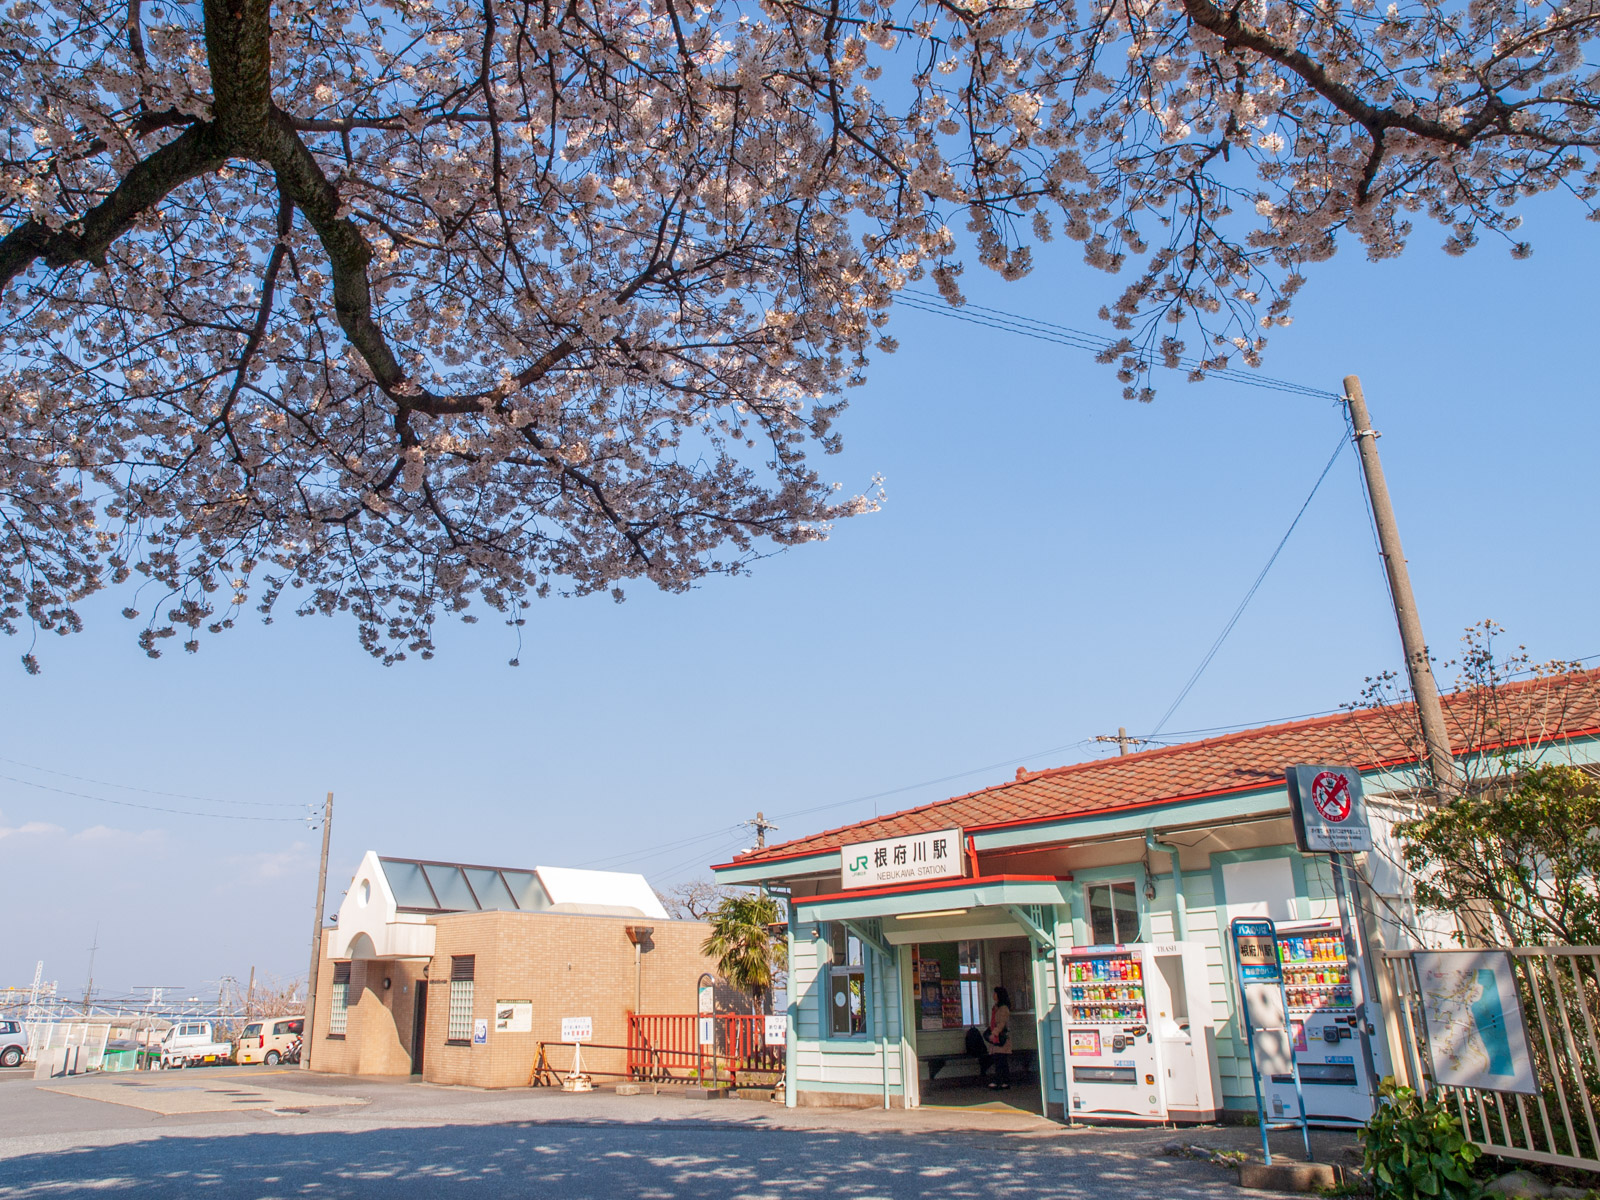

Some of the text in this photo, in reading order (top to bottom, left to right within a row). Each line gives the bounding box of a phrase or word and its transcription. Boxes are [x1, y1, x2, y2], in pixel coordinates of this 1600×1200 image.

[874, 839, 948, 868] 根府川駅
[849, 855, 868, 872] JR
[877, 865, 947, 880] NEBUKAWA STATION
[1238, 925, 1268, 934] バスのりば
[1240, 944, 1273, 957] 根府川駅
